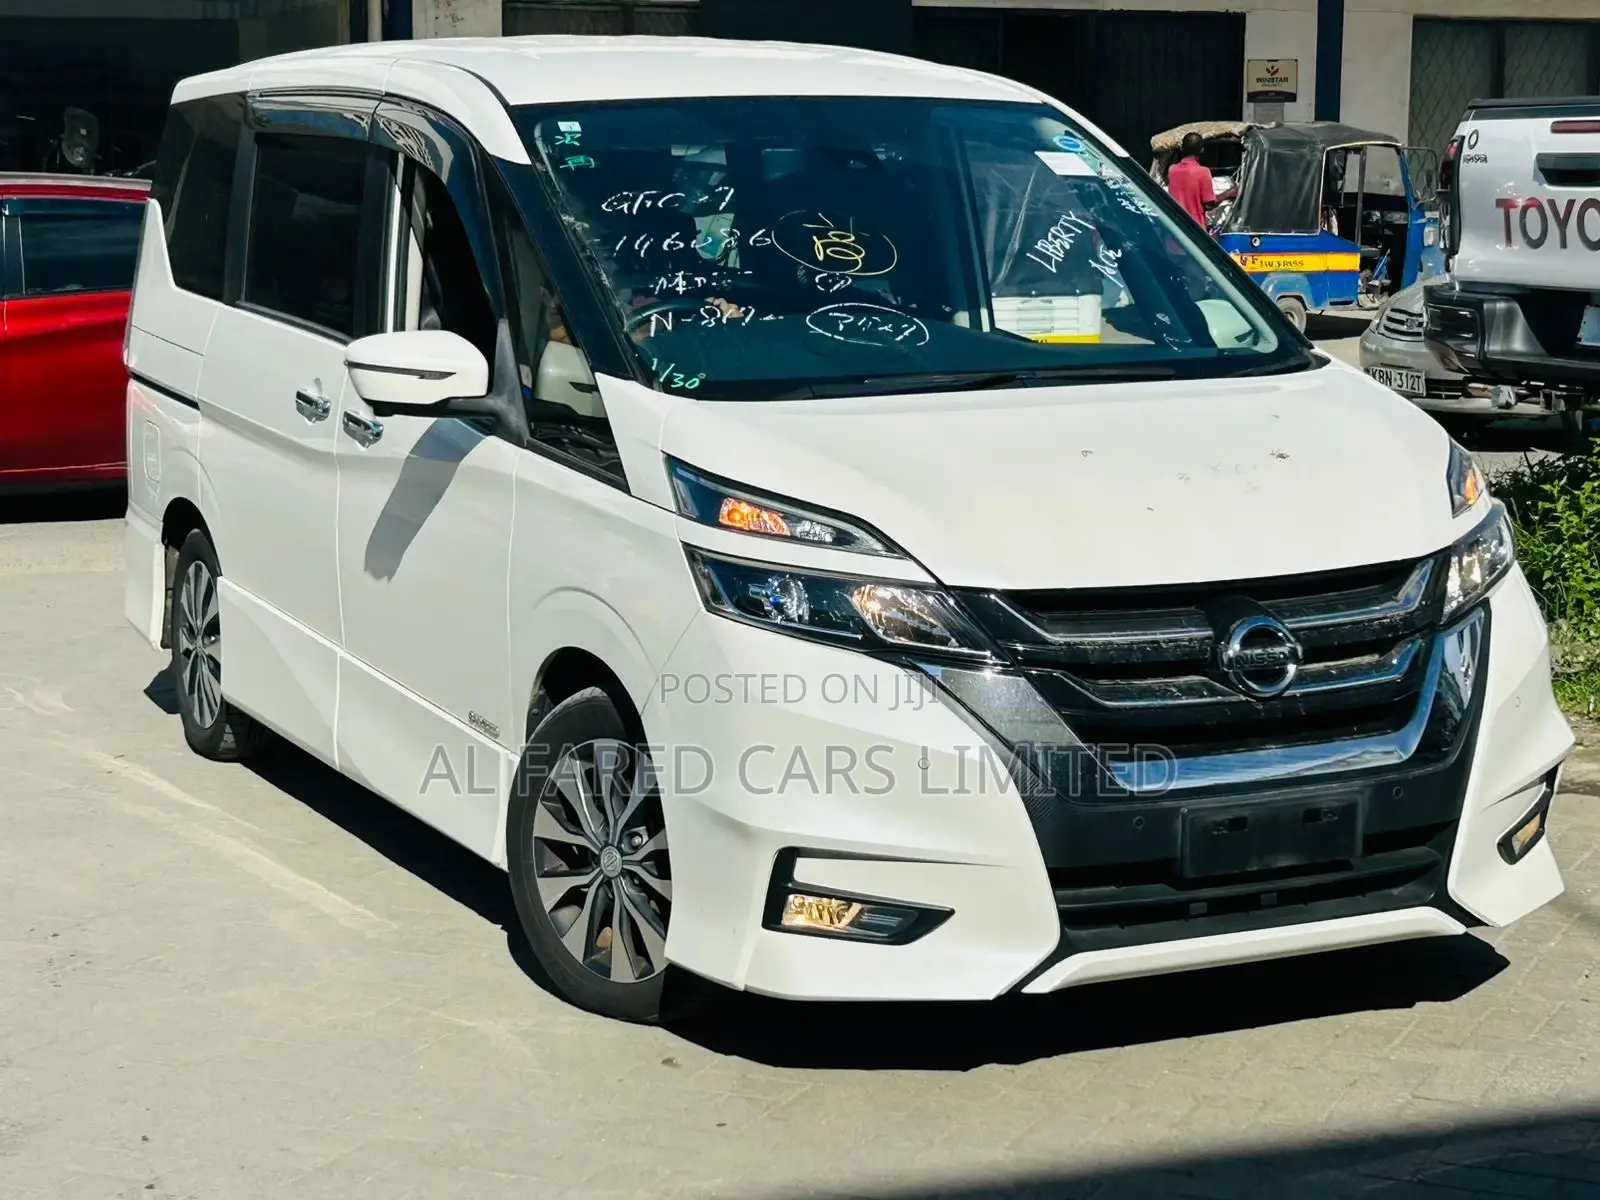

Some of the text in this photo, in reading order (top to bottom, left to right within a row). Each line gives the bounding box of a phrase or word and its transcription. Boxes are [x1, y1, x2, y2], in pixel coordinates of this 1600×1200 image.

[1026, 211, 1097, 273] LIBERTY
[1495, 197, 1600, 252] TOYO
[1371, 368, 1421, 391] KBN 312T
